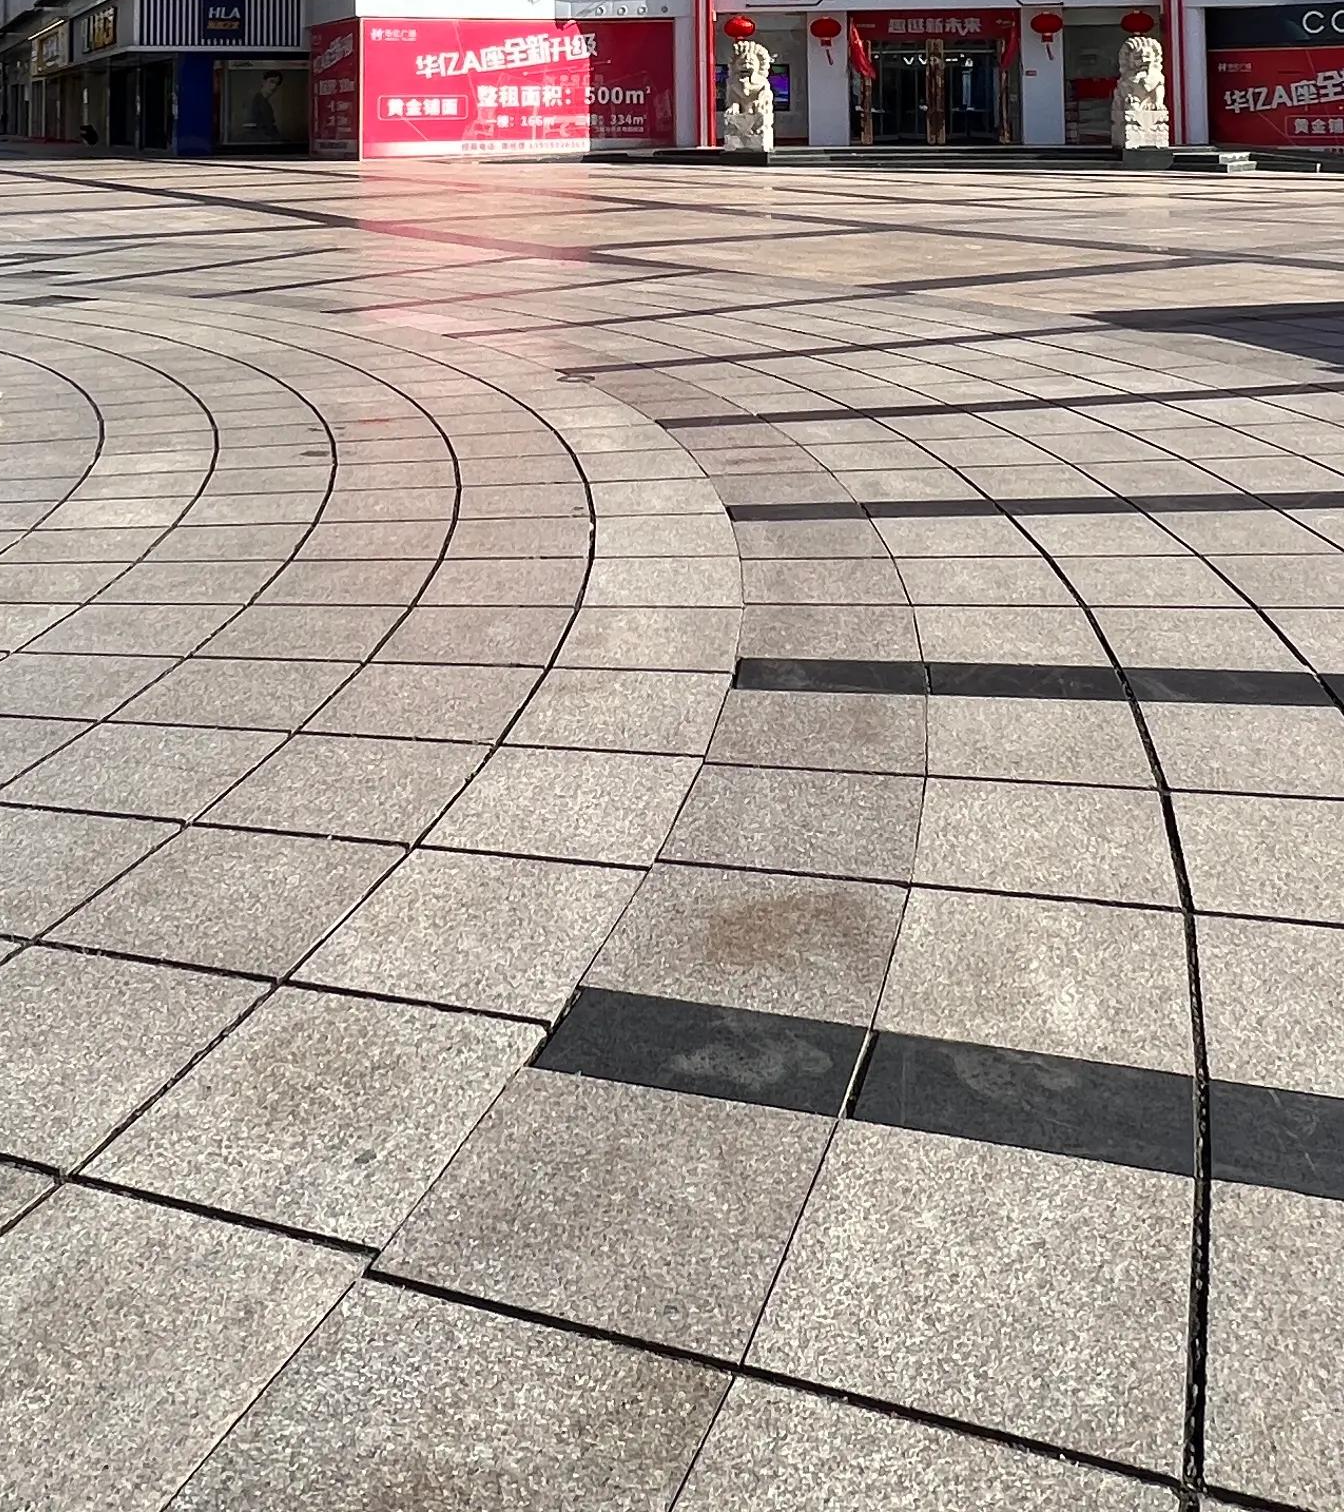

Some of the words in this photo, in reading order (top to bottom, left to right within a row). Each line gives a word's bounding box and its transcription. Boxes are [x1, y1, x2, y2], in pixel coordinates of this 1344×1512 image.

[208, 6, 241, 19] HLA
[416, 33, 598, 79] 华亿A座全新升级
